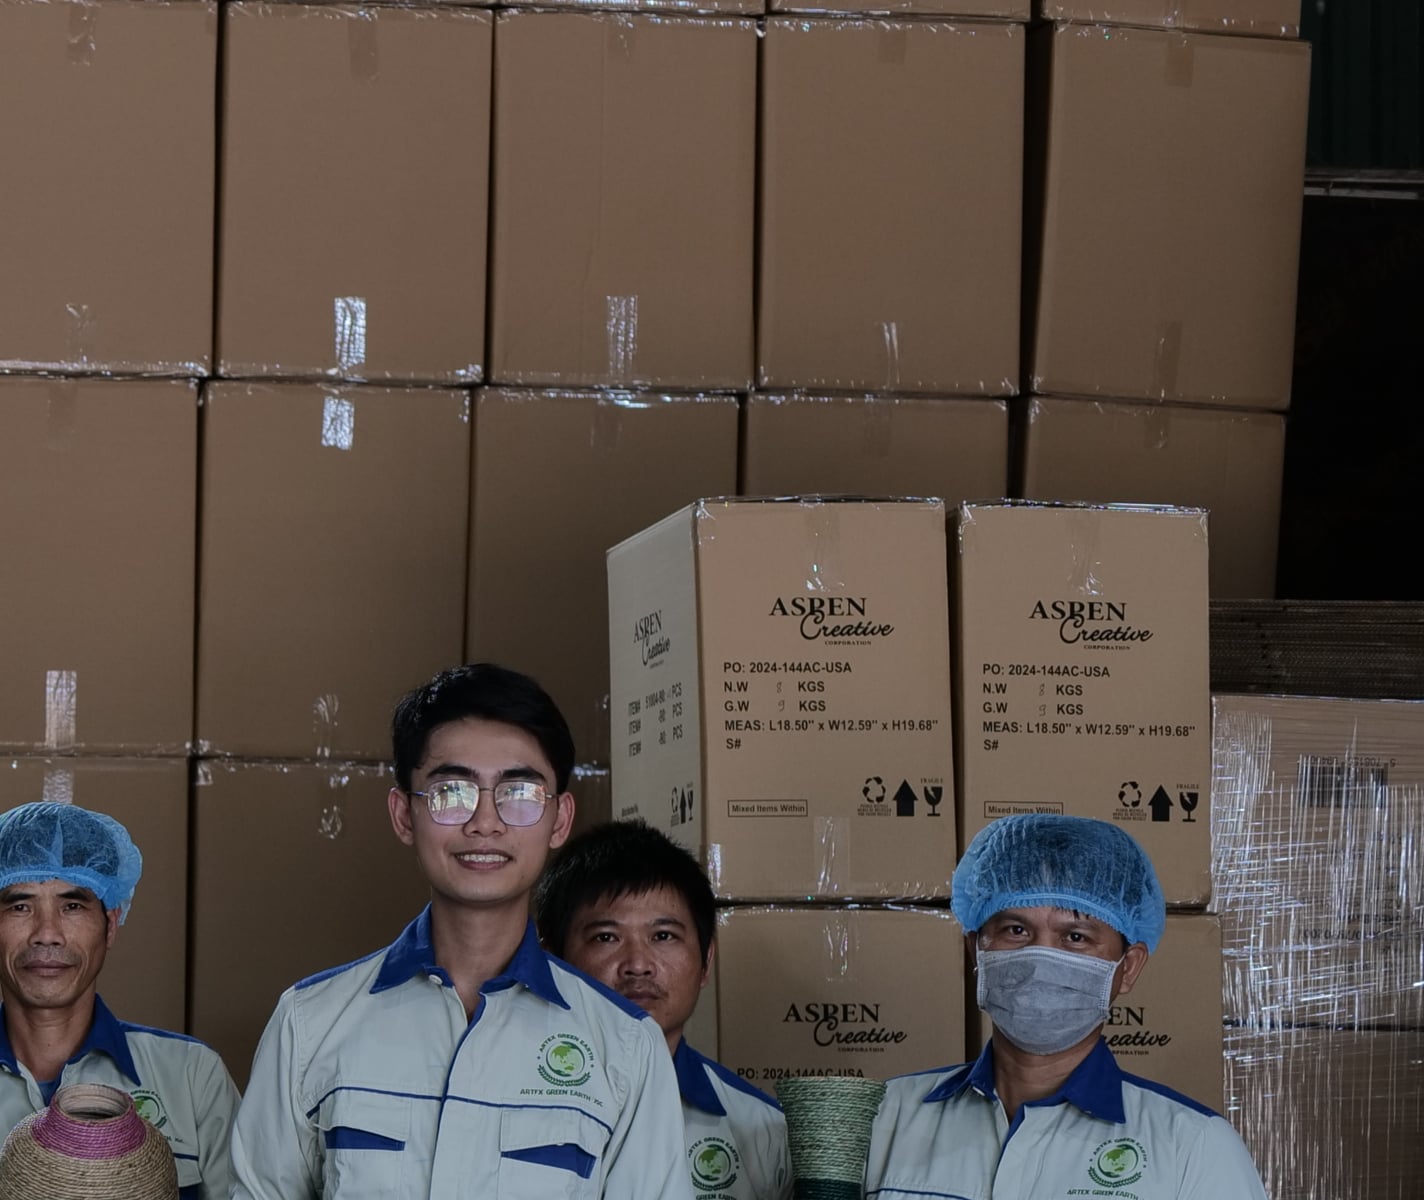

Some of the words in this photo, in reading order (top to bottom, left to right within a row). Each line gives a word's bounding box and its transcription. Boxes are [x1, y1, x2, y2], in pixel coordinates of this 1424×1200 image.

[769, 597, 867, 617] ASPEN
[1028, 600, 1127, 621] ASPEN
[800, 608, 894, 640] Creative
[1059, 613, 1153, 644] Creative
[723, 662, 745, 673] PO:
[749, 662, 852, 673] 2024-144AC-USA
[983, 664, 1005, 675] PO:
[1008, 664, 1110, 677] 2024-144AC-USA
[724, 681, 749, 692] N.W
[798, 681, 825, 692] KGS
[983, 683, 1007, 694] N.W
[1056, 684, 1083, 696] KGS
[724, 700, 750, 712] G.W
[799, 700, 826, 712] KGS
[983, 702, 1008, 713] G.W
[1057, 704, 1084, 715] KGS
[724, 720, 765, 731] MEAS:
[818, 722, 825, 731] x
[882, 722, 888, 731] x
[983, 721, 1023, 733] MEAS:
[1076, 726, 1082, 734] x
[1139, 727, 1145, 736] x
[726, 738, 741, 749] S#
[984, 739, 999, 751] S#
[732, 804, 755, 813] Mixed
[756, 804, 778, 813] Items
[780, 804, 805, 813] Within
[988, 806, 1011, 815] Mixed
[1012, 806, 1034, 815] Items
[1036, 807, 1060, 815] Within
[783, 1003, 880, 1023] ASPEN
[814, 1016, 907, 1046] Creative
[737, 1068, 759, 1079] PO:
